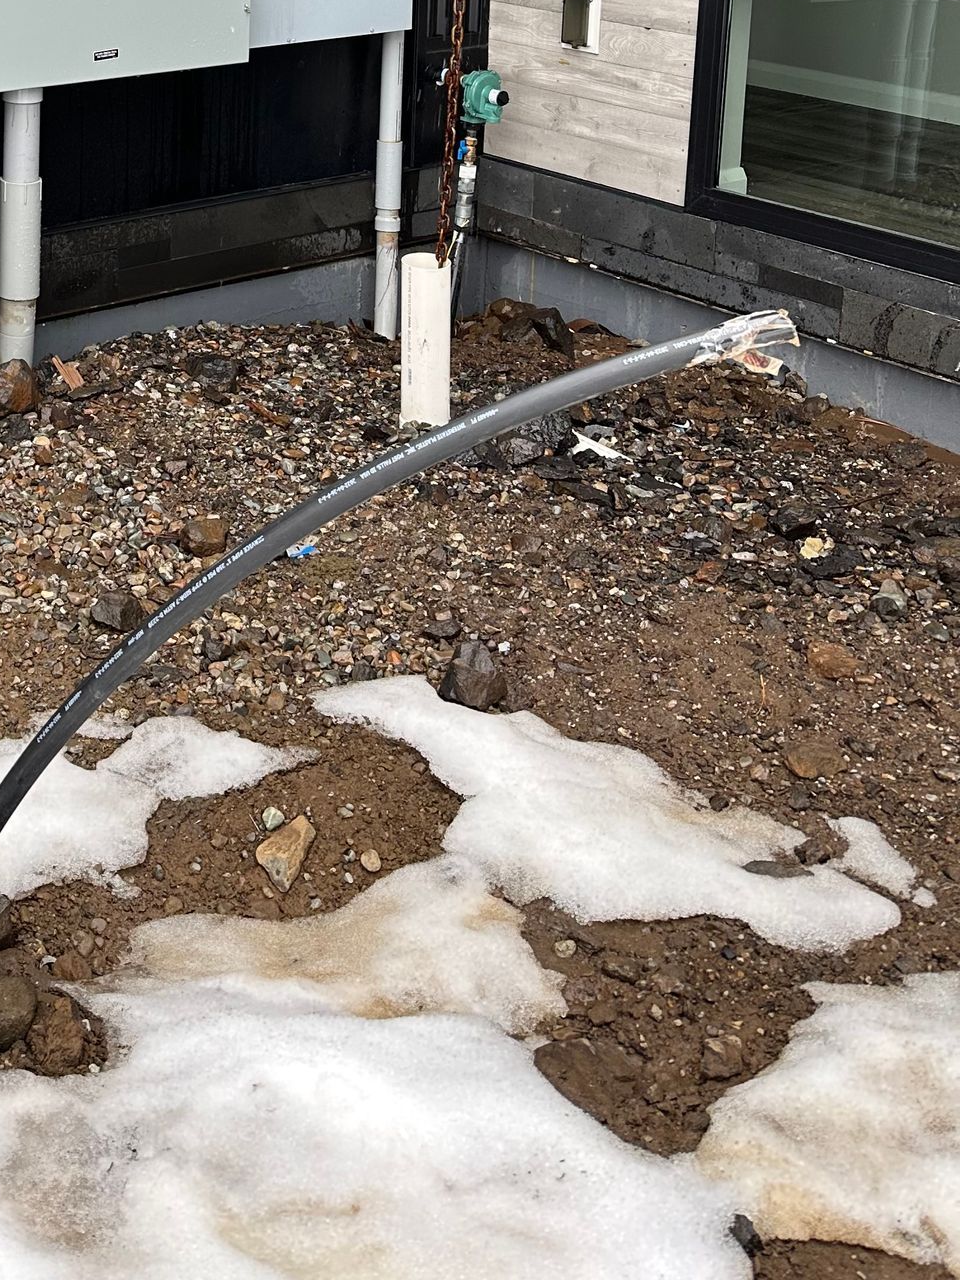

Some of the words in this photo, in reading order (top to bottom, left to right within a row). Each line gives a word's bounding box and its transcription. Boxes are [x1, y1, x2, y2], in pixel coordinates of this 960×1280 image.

[435, 422, 467, 441] INTERSTATE
[391, 452, 405, 464] POST
[359, 470, 371, 480] USA
[242, 535, 265, 554] SERVICE
[231, 549, 244, 562] PIPE
[206, 569, 217, 580] PSI
[162, 601, 176, 616] ASTM
